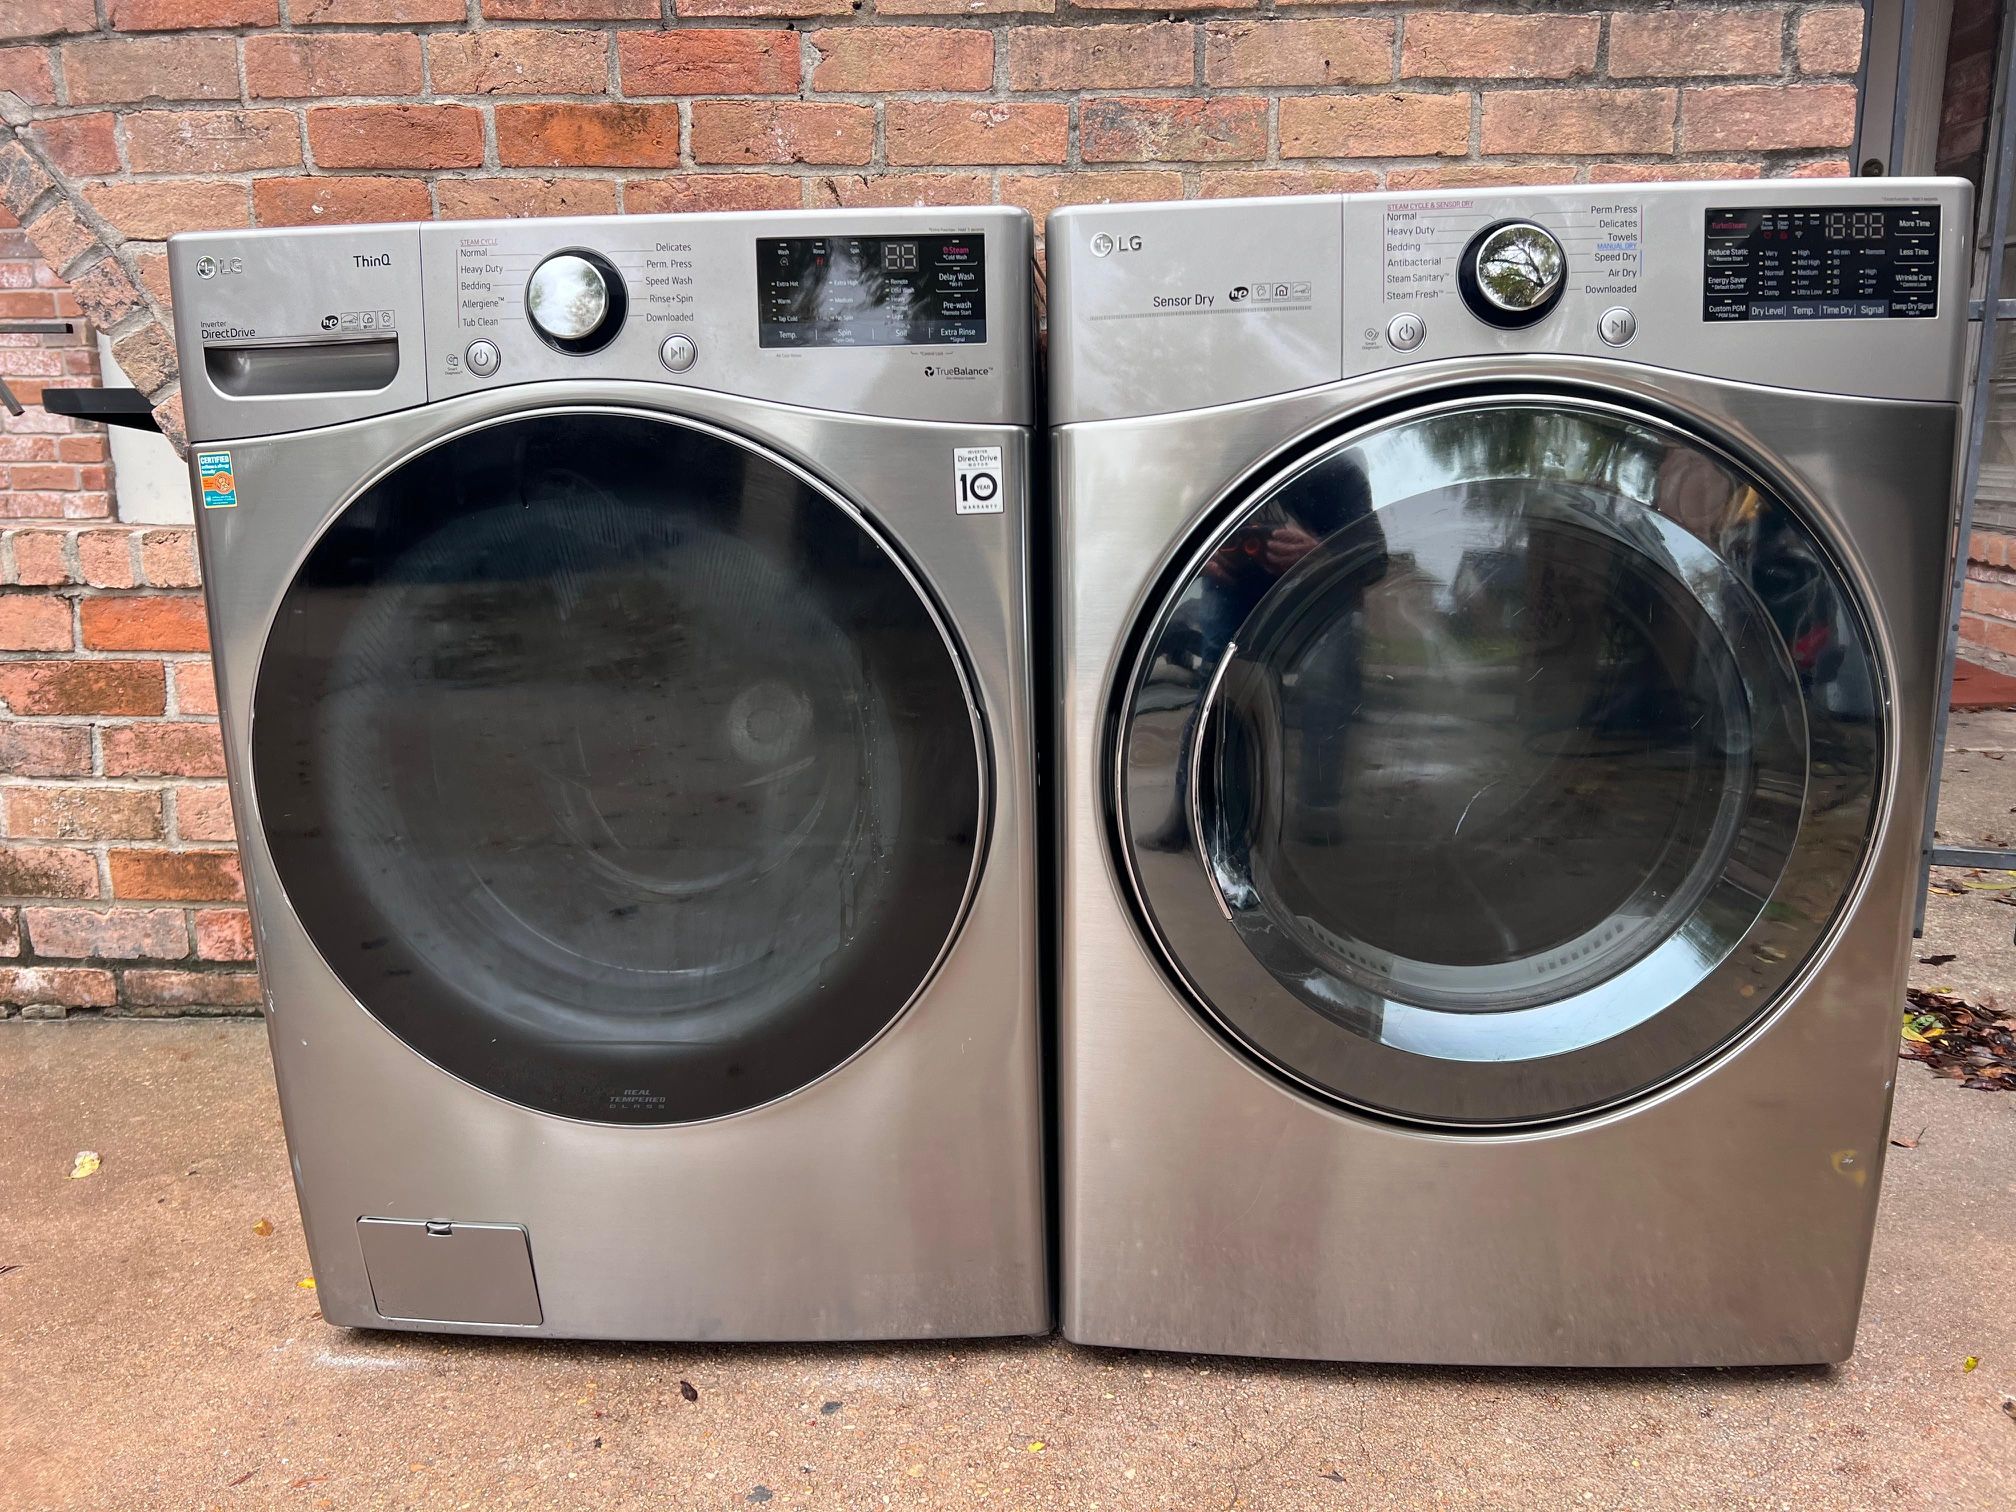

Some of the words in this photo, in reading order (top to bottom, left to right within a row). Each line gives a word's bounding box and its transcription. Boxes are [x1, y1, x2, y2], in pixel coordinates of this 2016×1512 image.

[1615, 205, 1637, 213] Press
[1387, 213, 1417, 221] Normal
[1600, 220, 1637, 228] Delicates
[1387, 227, 1413, 236] Heavy
[1416, 227, 1434, 235] Duty
[1608, 233, 1637, 241] Towels
[656, 243, 691, 251] Delicates
[1118, 236, 1142, 251] LG
[1387, 243, 1420, 252] Bedding
[461, 249, 488, 257] Normal
[1595, 253, 1620, 262] Speed
[1622, 253, 1637, 261] Dry
[353, 253, 391, 268] ThinQ
[671, 260, 692, 268] Press
[1388, 258, 1441, 267] Antibacterial
[220, 257, 243, 275] LG
[461, 265, 483, 275] Heavy
[485, 265, 503, 274] Duty
[939, 273, 957, 281] Delay
[958, 272, 974, 280] Wash
[1608, 269, 1620, 277] Air
[1623, 269, 1637, 278] Dry
[646, 277, 669, 286] Speed
[672, 277, 692, 285] Wash
[461, 282, 491, 291] Bedding
[1585, 286, 1637, 294] Downloaded
[1153, 296, 1192, 307] Sensor
[1195, 294, 1214, 306] Dry
[1387, 292, 1413, 300] Steam
[1751, 307, 1764, 316] Dry
[1765, 307, 1784, 315] Level
[1793, 306, 1815, 315] Temp.
[1841, 306, 1853, 314] Dry
[1861, 305, 1884, 315] Signal
[463, 318, 476, 327] Tub
[478, 318, 498, 326] Clean
[779, 331, 797, 339] Temp.
[960, 473, 997, 501] 10
